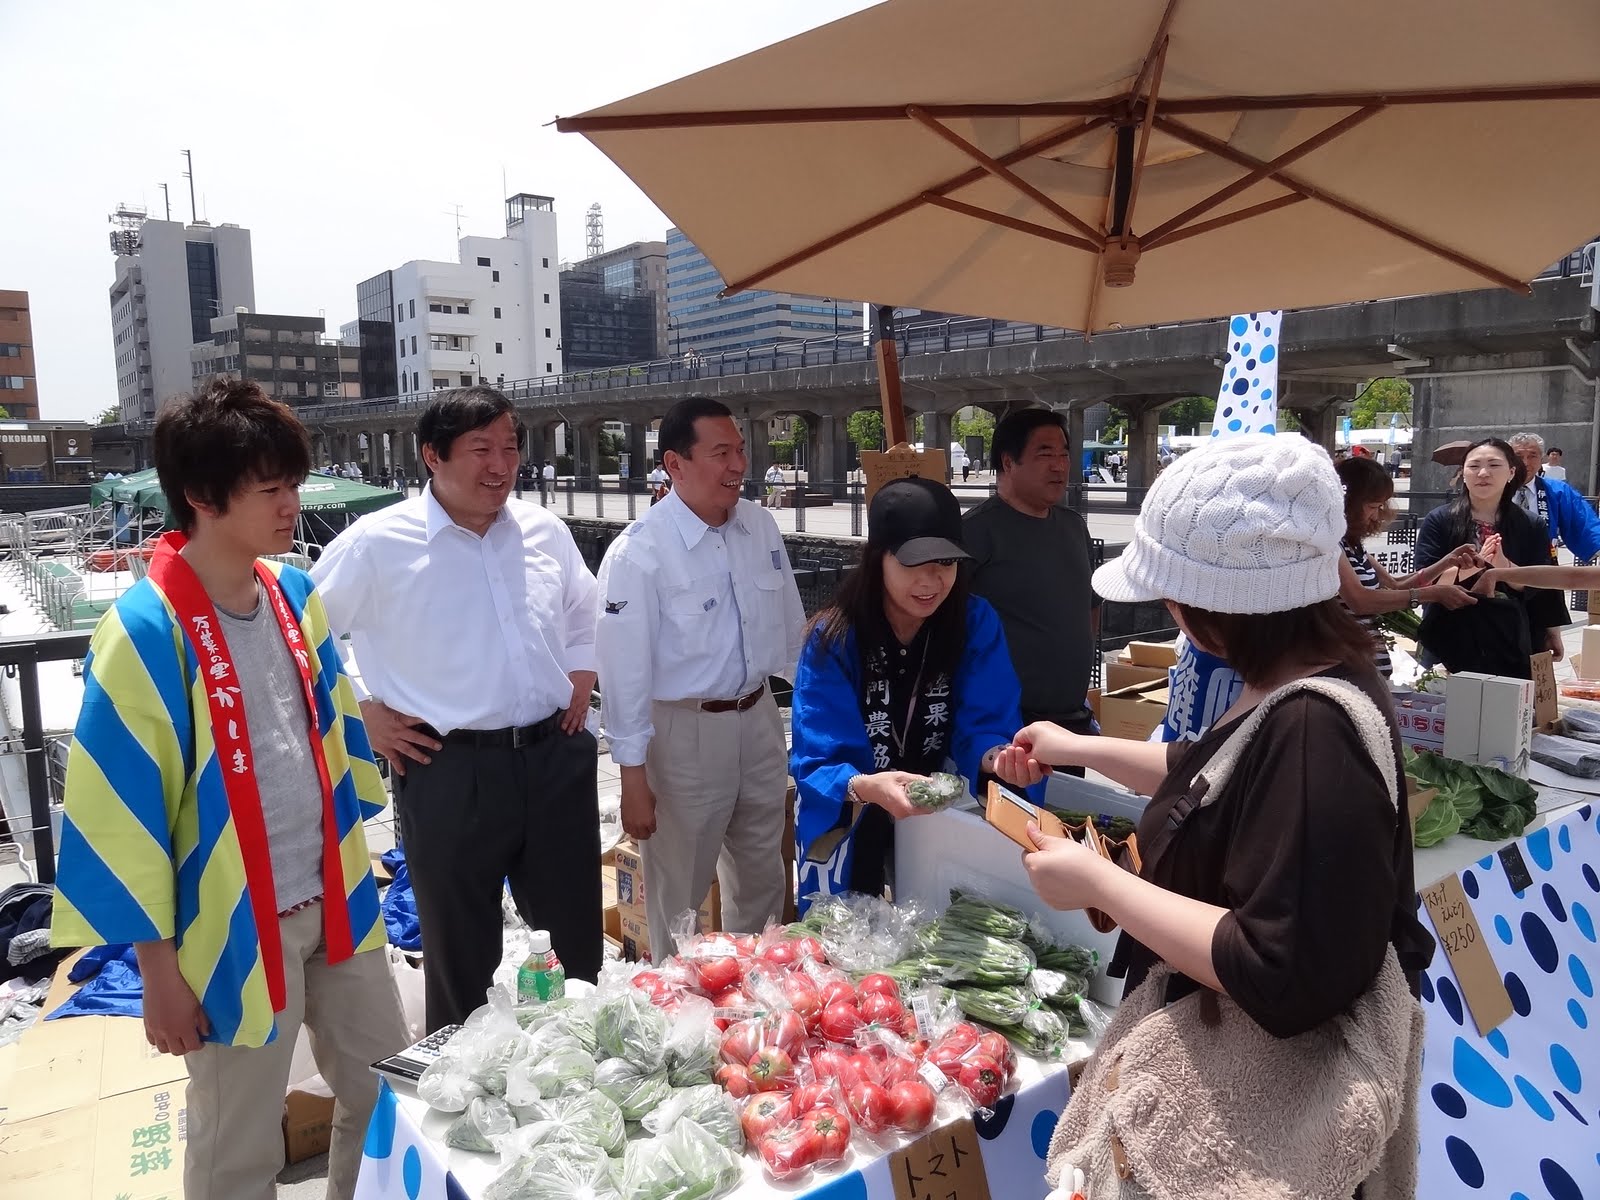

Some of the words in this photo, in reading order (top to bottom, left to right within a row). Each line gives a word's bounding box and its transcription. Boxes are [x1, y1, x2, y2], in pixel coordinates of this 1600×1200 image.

[0, 434, 47, 443] OKOHAMA
[865, 646, 892, 769] 門農協
[1441, 922, 1476, 956] ¥250
[904, 1135, 969, 1199] トマト
